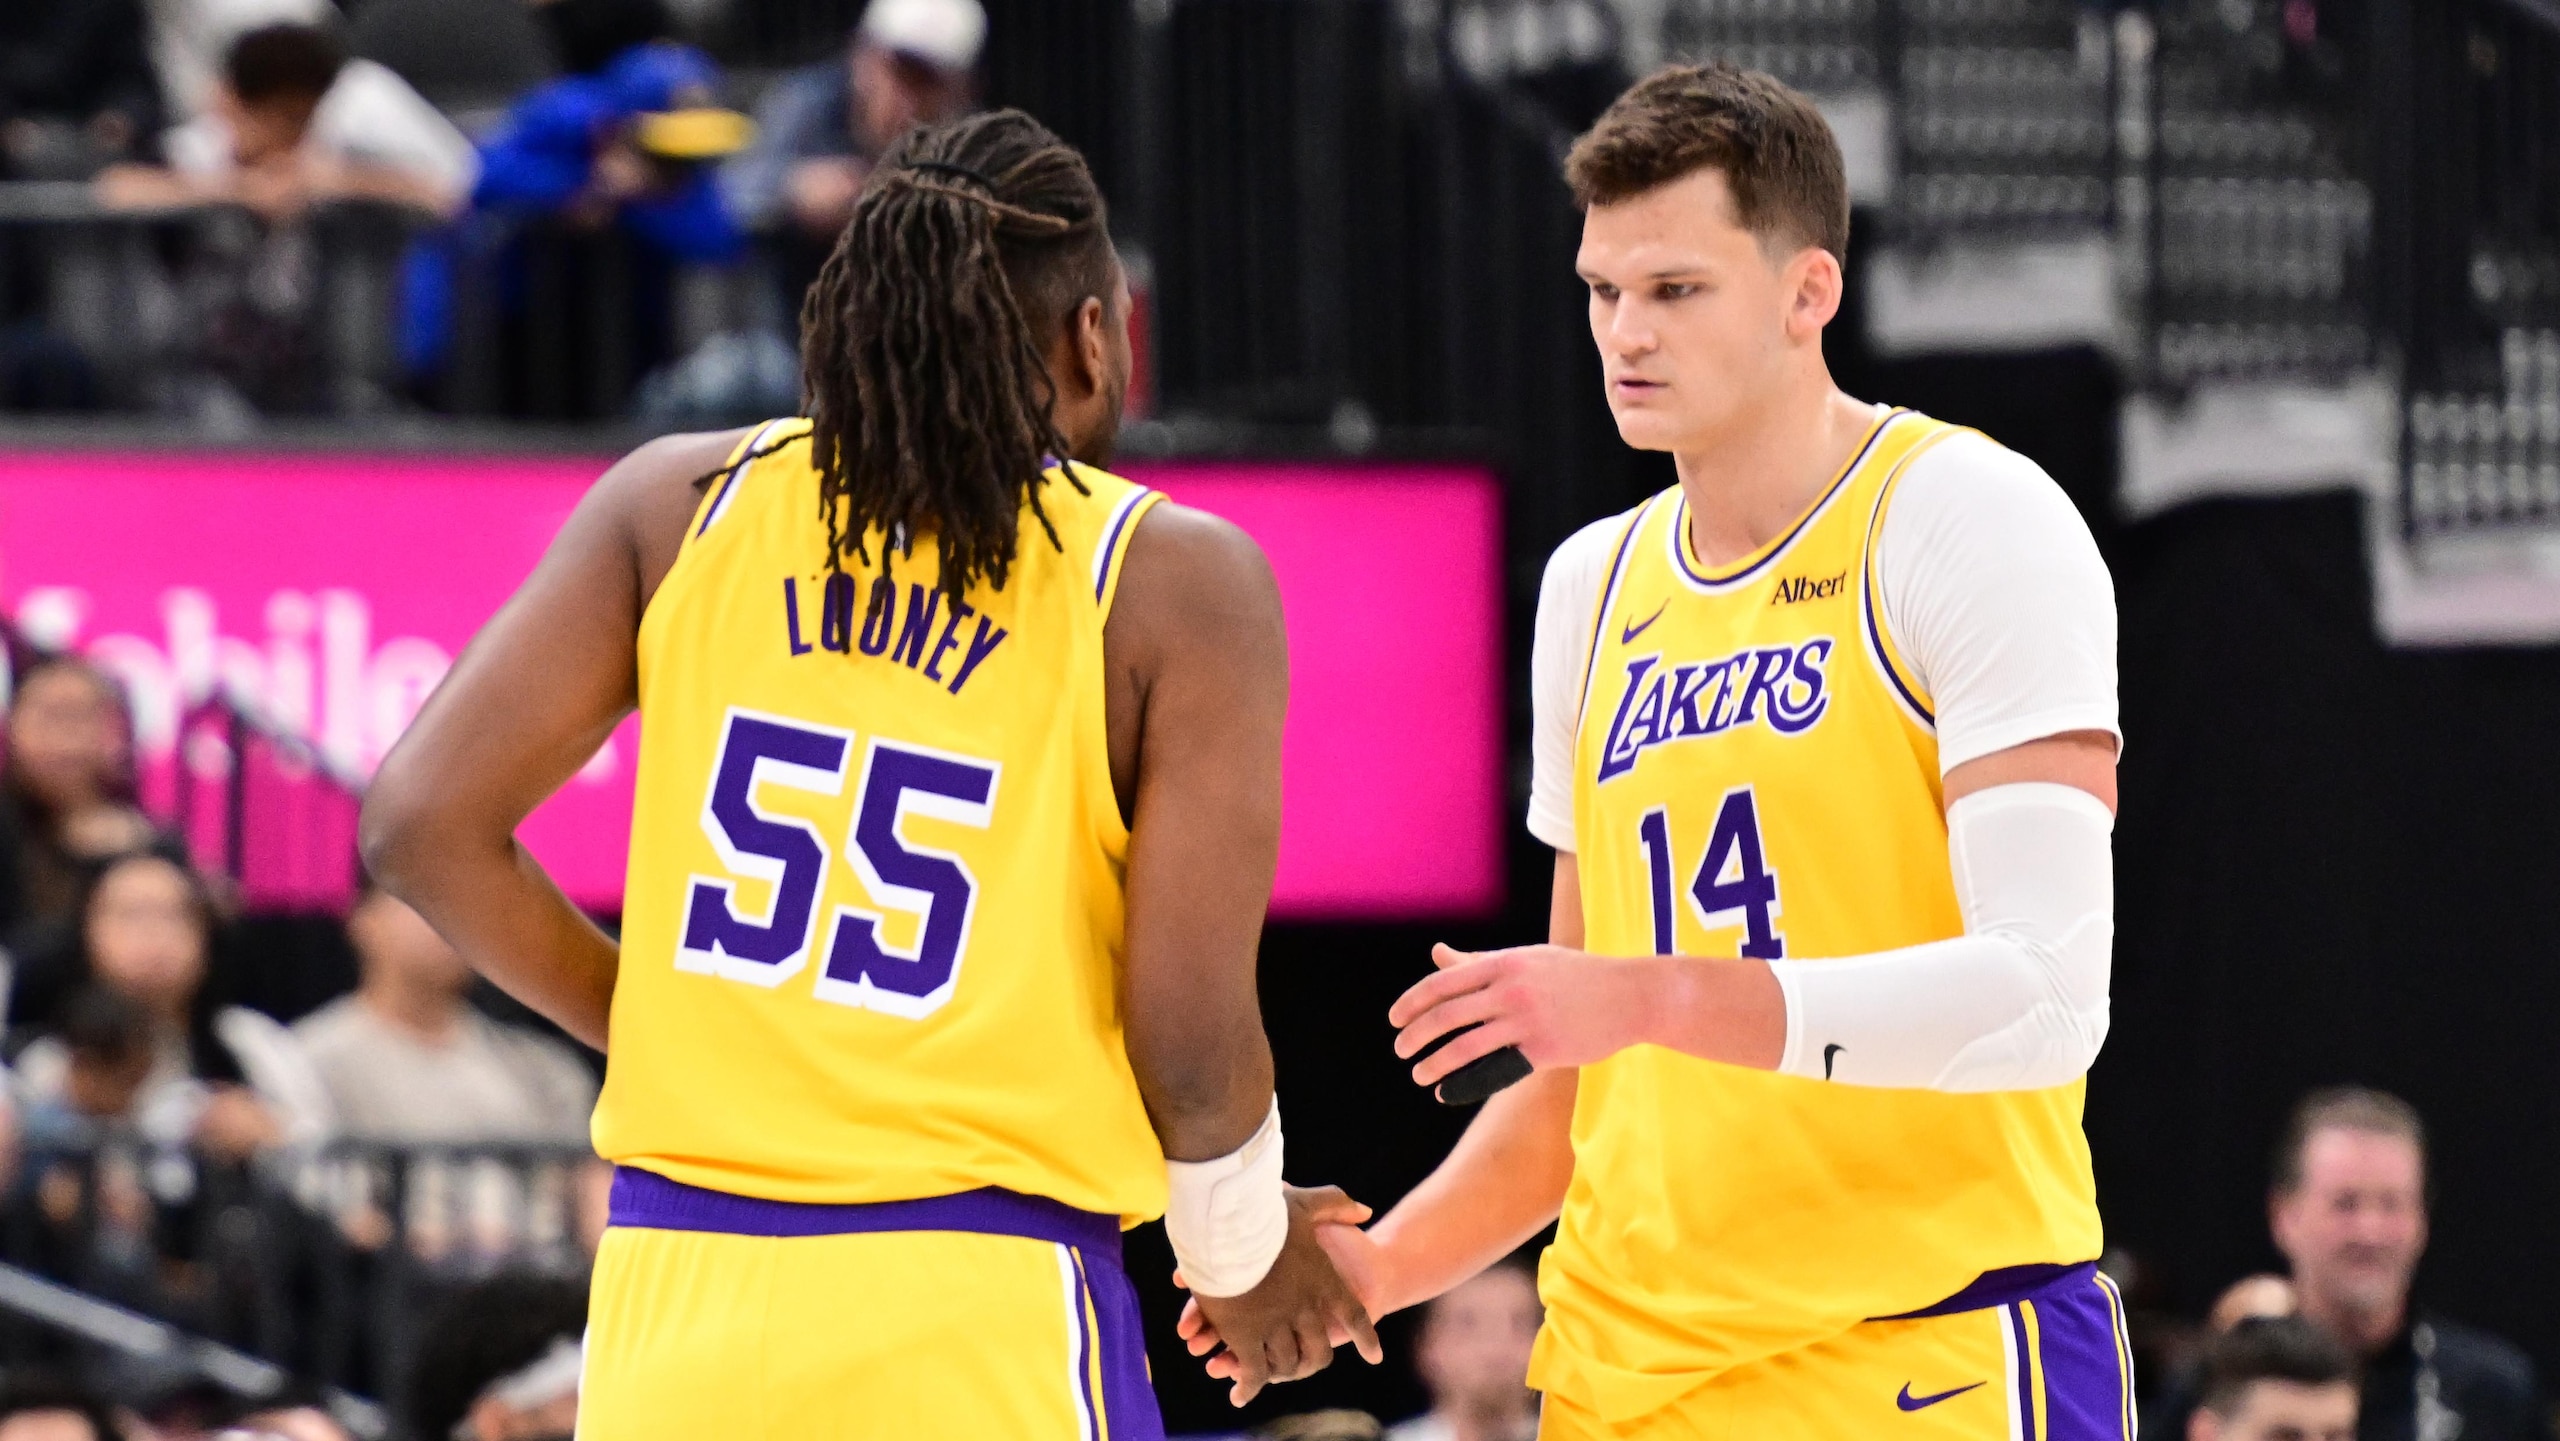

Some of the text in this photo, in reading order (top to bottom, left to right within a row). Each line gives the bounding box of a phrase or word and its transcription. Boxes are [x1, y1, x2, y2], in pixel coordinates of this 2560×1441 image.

[783, 571, 1009, 696] LOONEY
[1771, 568, 1847, 606] Albert
[1597, 636, 1836, 785] LAKERS
[675, 707, 1001, 1020] 55
[1641, 785, 1786, 960] 14
